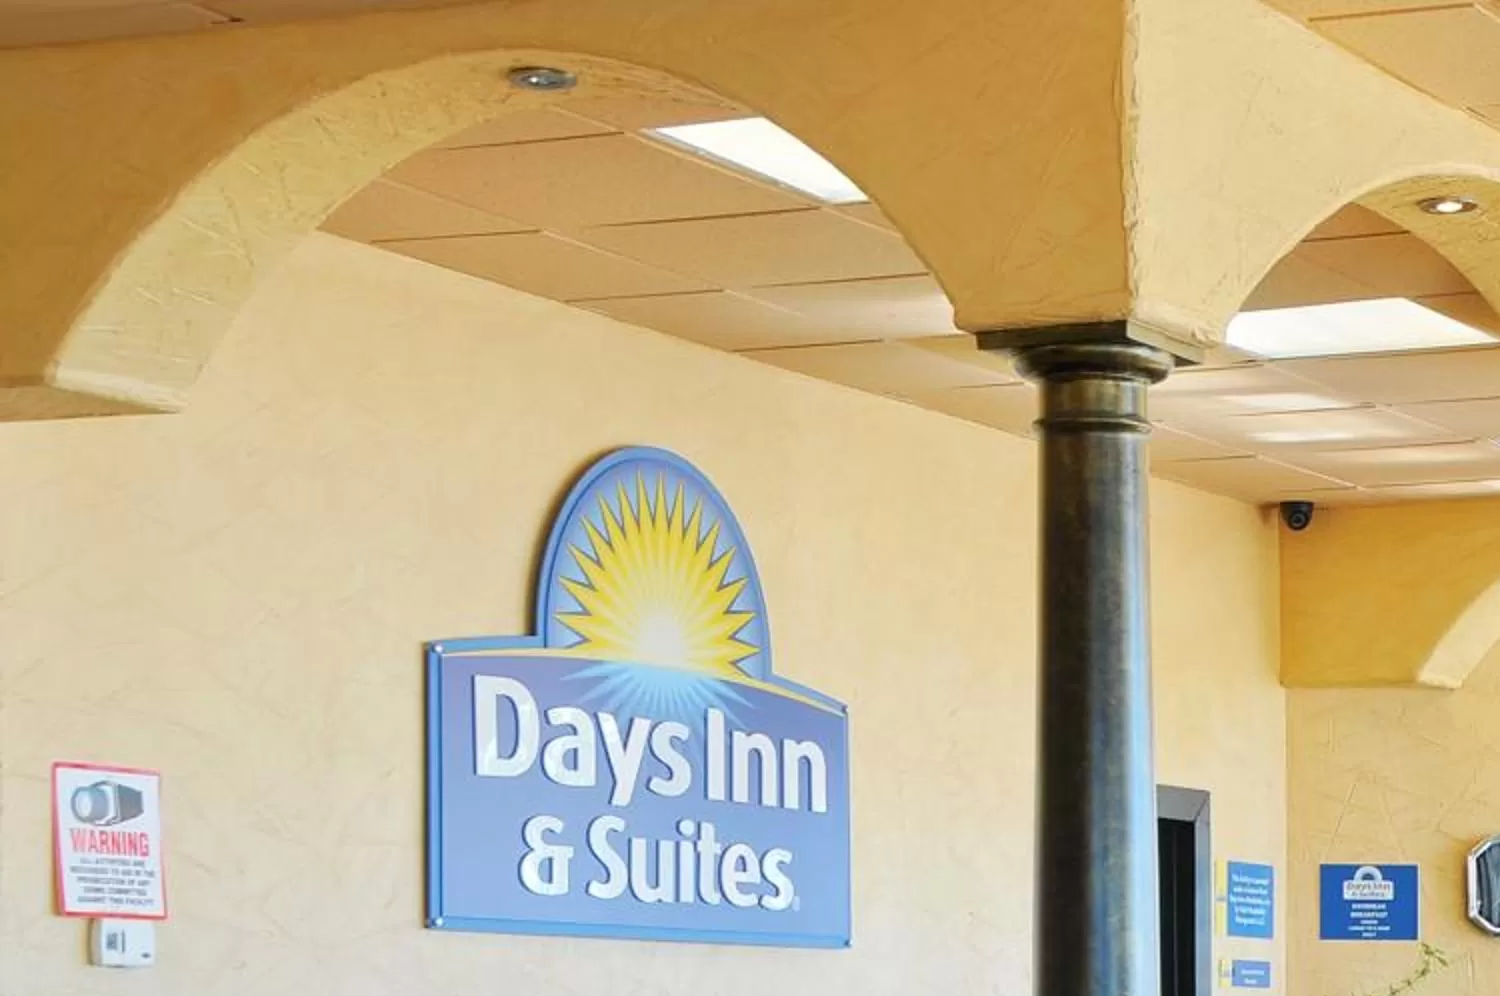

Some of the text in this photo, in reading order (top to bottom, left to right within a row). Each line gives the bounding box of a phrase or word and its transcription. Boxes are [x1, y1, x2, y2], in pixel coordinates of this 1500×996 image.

[473, 674, 827, 814] Days Inn
[70, 828, 149, 857] WARNING
[519, 815, 795, 912] & Suites
